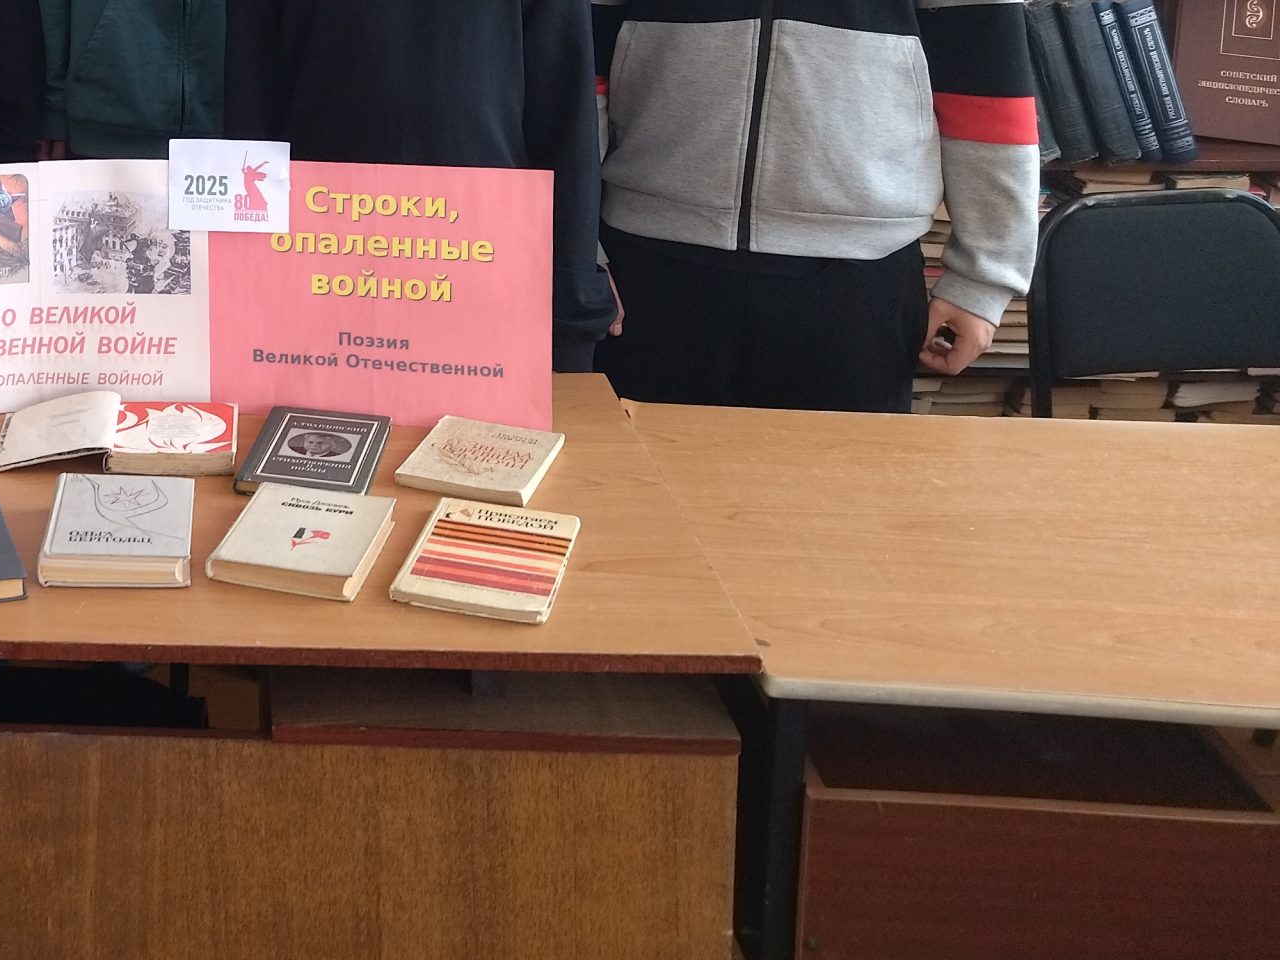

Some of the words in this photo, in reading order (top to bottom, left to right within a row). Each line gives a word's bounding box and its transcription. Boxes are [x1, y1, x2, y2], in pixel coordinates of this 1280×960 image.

[1220, 70, 1277, 82] СОВЕТСКИЙ
[1225, 96, 1269, 107] СЛОВАРЬ
[184, 174, 228, 196] 2025
[305, 186, 460, 223] Строки,
[233, 212, 269, 222] ПОБЕДА!
[270, 232, 495, 262] опаленные
[311, 269, 453, 302] войной
[1, 309, 17, 327] О
[29, 302, 137, 325] ВЕЛИКОЙ
[97, 332, 177, 355] ВОЙНЕ
[338, 332, 410, 350] Поэзия
[252, 349, 338, 367] Великой
[346, 353, 505, 378] Отечественной
[97, 370, 164, 386] ВОЙНОЙ
